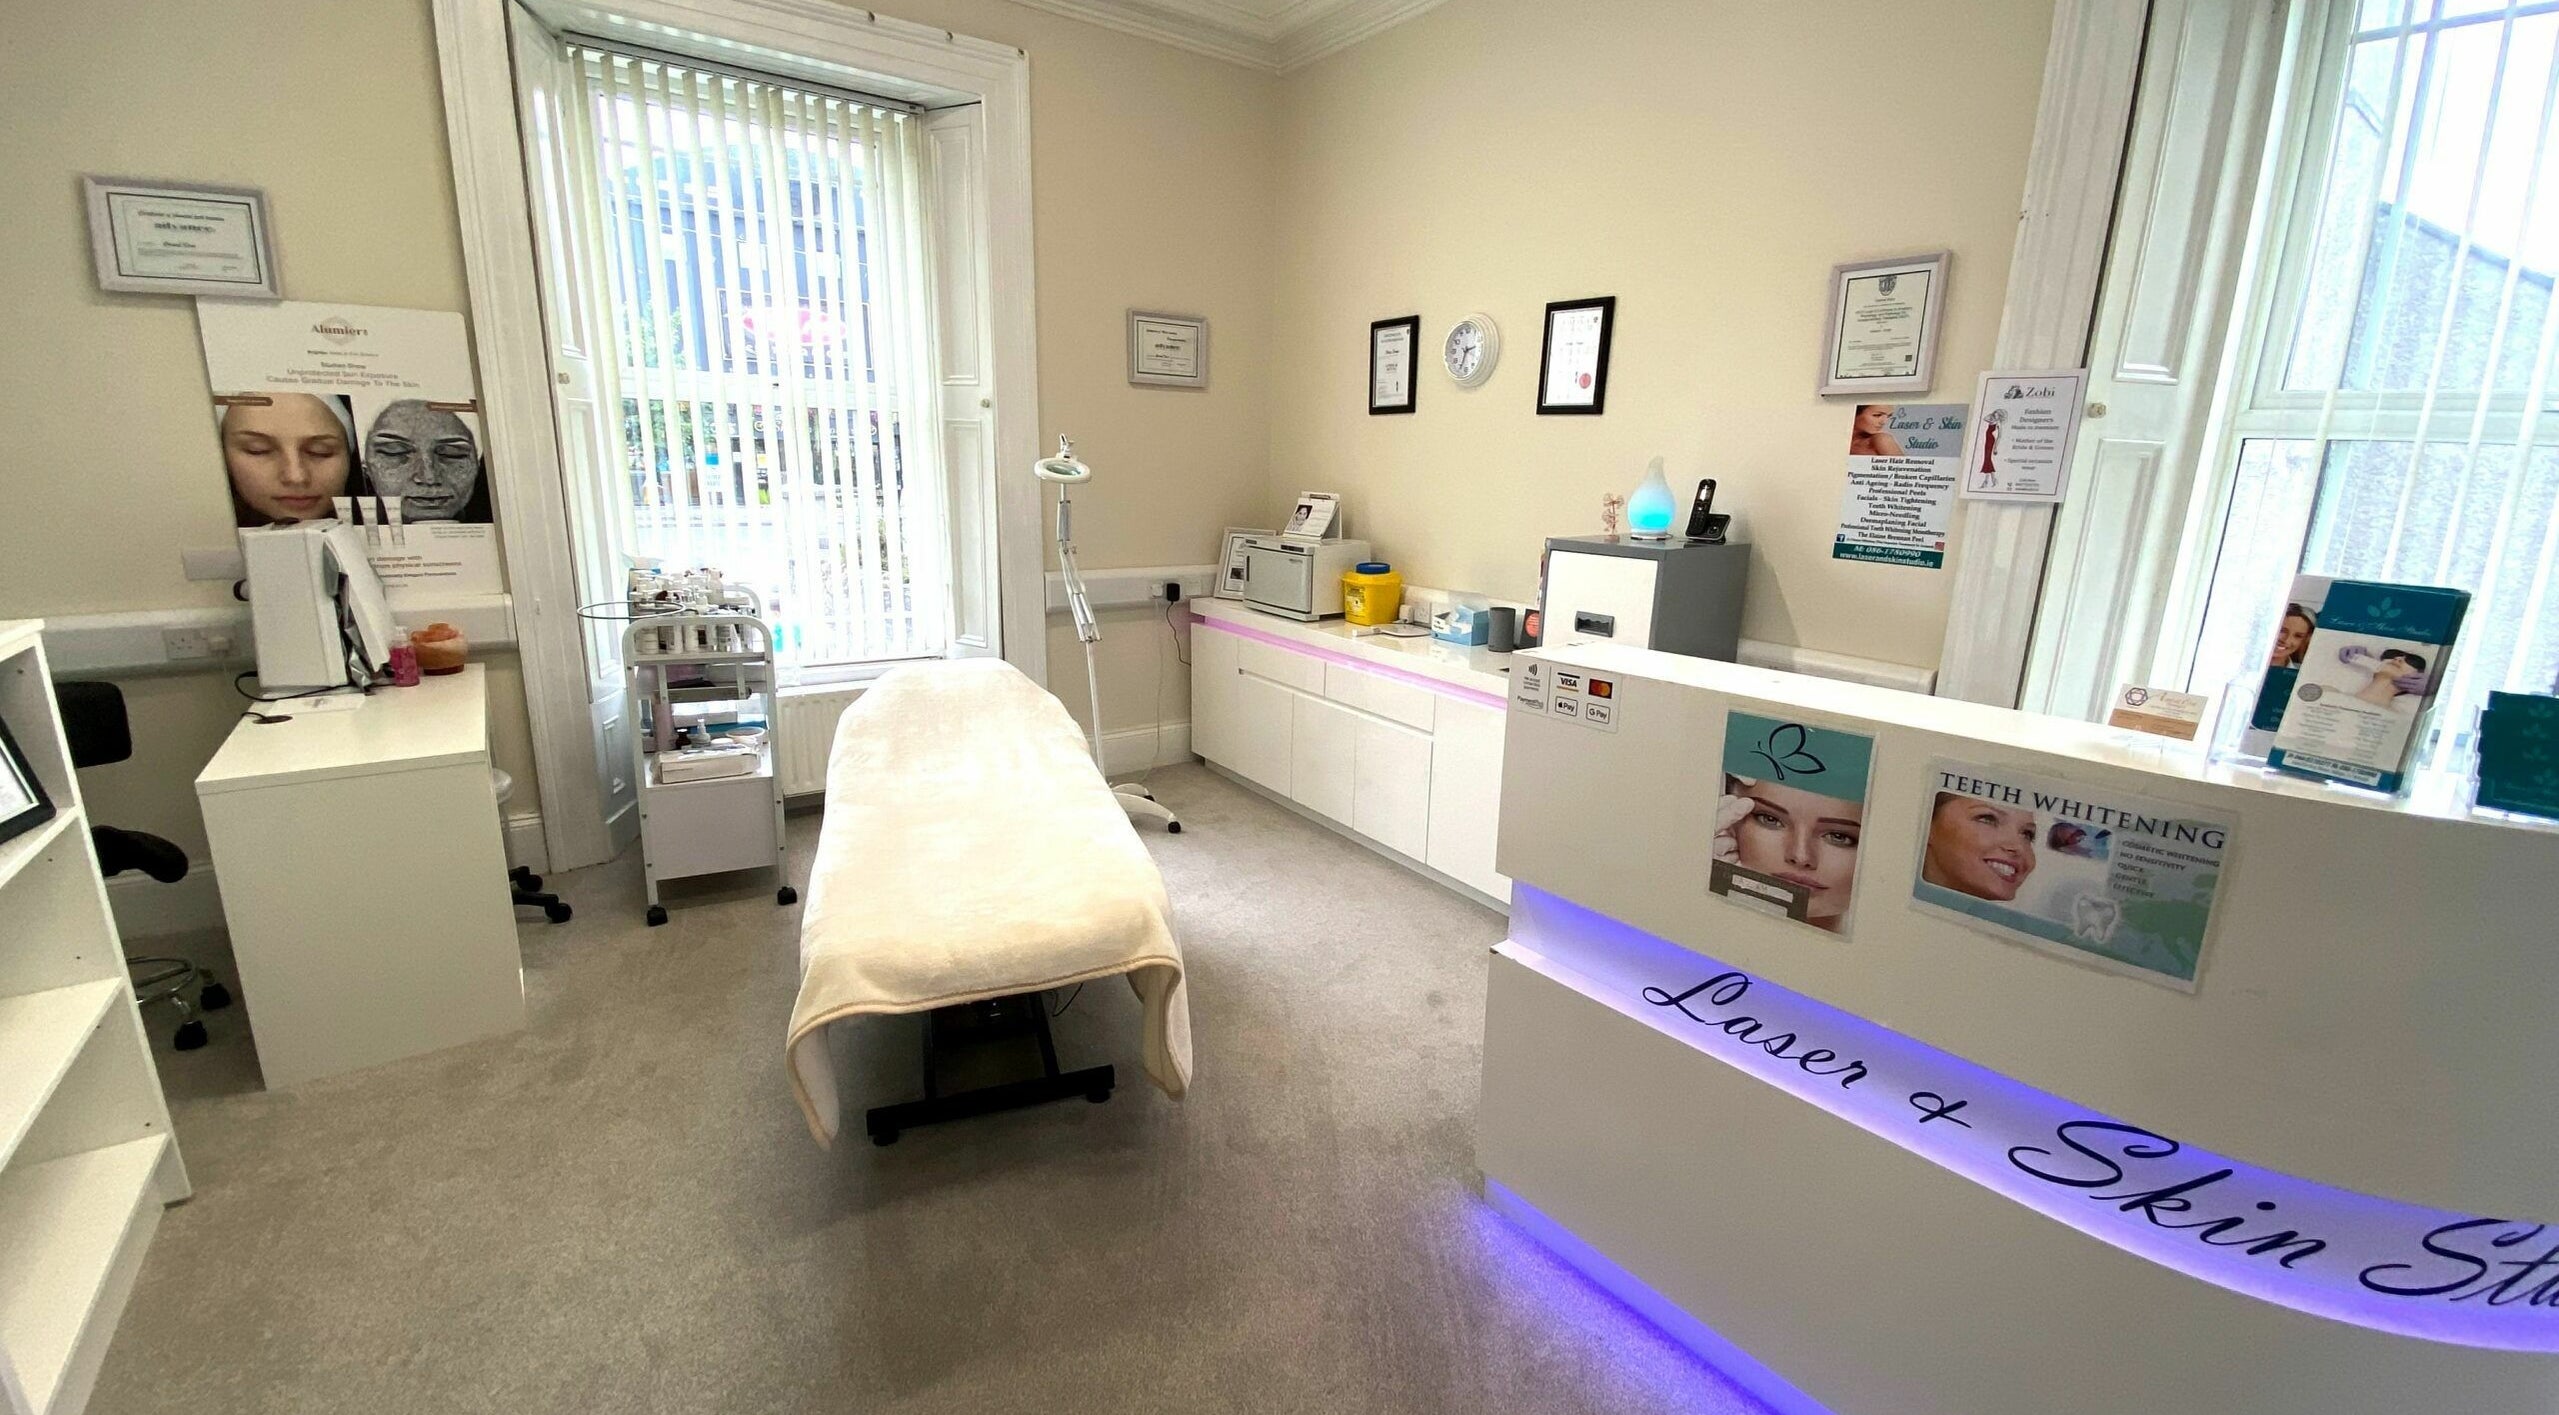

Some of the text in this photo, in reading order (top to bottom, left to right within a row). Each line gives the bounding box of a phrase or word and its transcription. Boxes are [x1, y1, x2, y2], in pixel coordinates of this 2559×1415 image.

[2026, 386, 2056, 398] Zobi
[1889, 416, 1962, 430] Laser & Skin
[1905, 436, 1939, 449] Studio
[1919, 474, 1955, 482] Capillaries
[1914, 482, 1949, 490] Frequency
[1900, 497, 1936, 505] Tightening
[1888, 504, 1921, 512] Whitening
[1869, 510, 1920, 519] Micro-Needling
[1860, 517, 1906, 527] Dermaplaning
[1560, 678, 1577, 687] VISA
[1564, 702, 1575, 712] Pay
[1596, 710, 1607, 719] Pay
[1940, 772, 2226, 850] TEETH WHITENING
[2122, 840, 2220, 868] COSMETIC WHITENING
[2120, 851, 2186, 871] NO SENSITIVITY
[1642, 972, 1868, 1089] Laser
[2006, 1120, 2327, 1269] Skin
